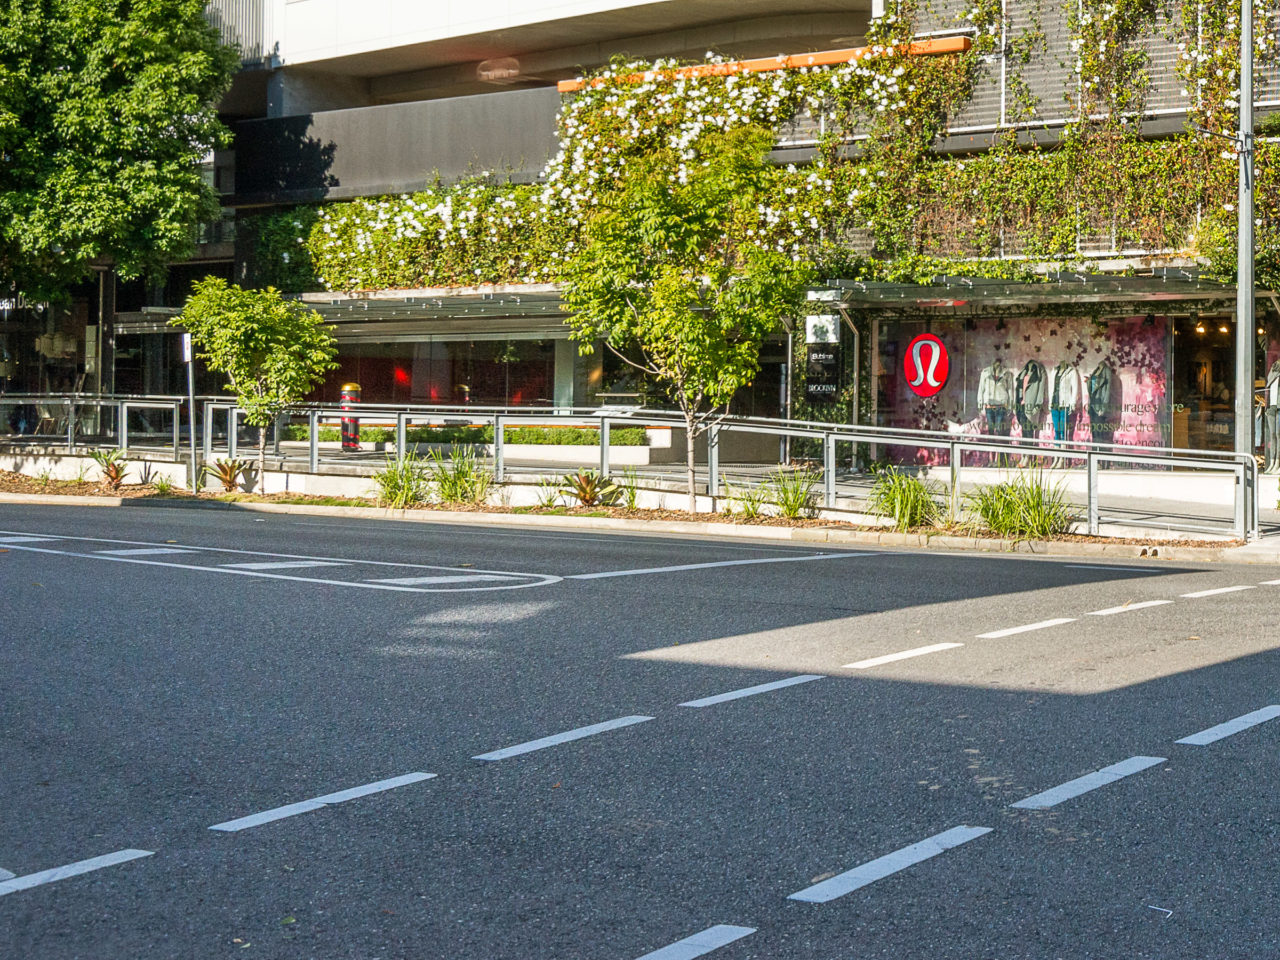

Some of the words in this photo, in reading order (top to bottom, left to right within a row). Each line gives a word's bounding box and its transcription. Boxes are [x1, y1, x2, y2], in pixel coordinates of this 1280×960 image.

[17, 294, 49, 313] Degn
[1076, 419, 1133, 435] impossible
[1135, 419, 1172, 433] dream
